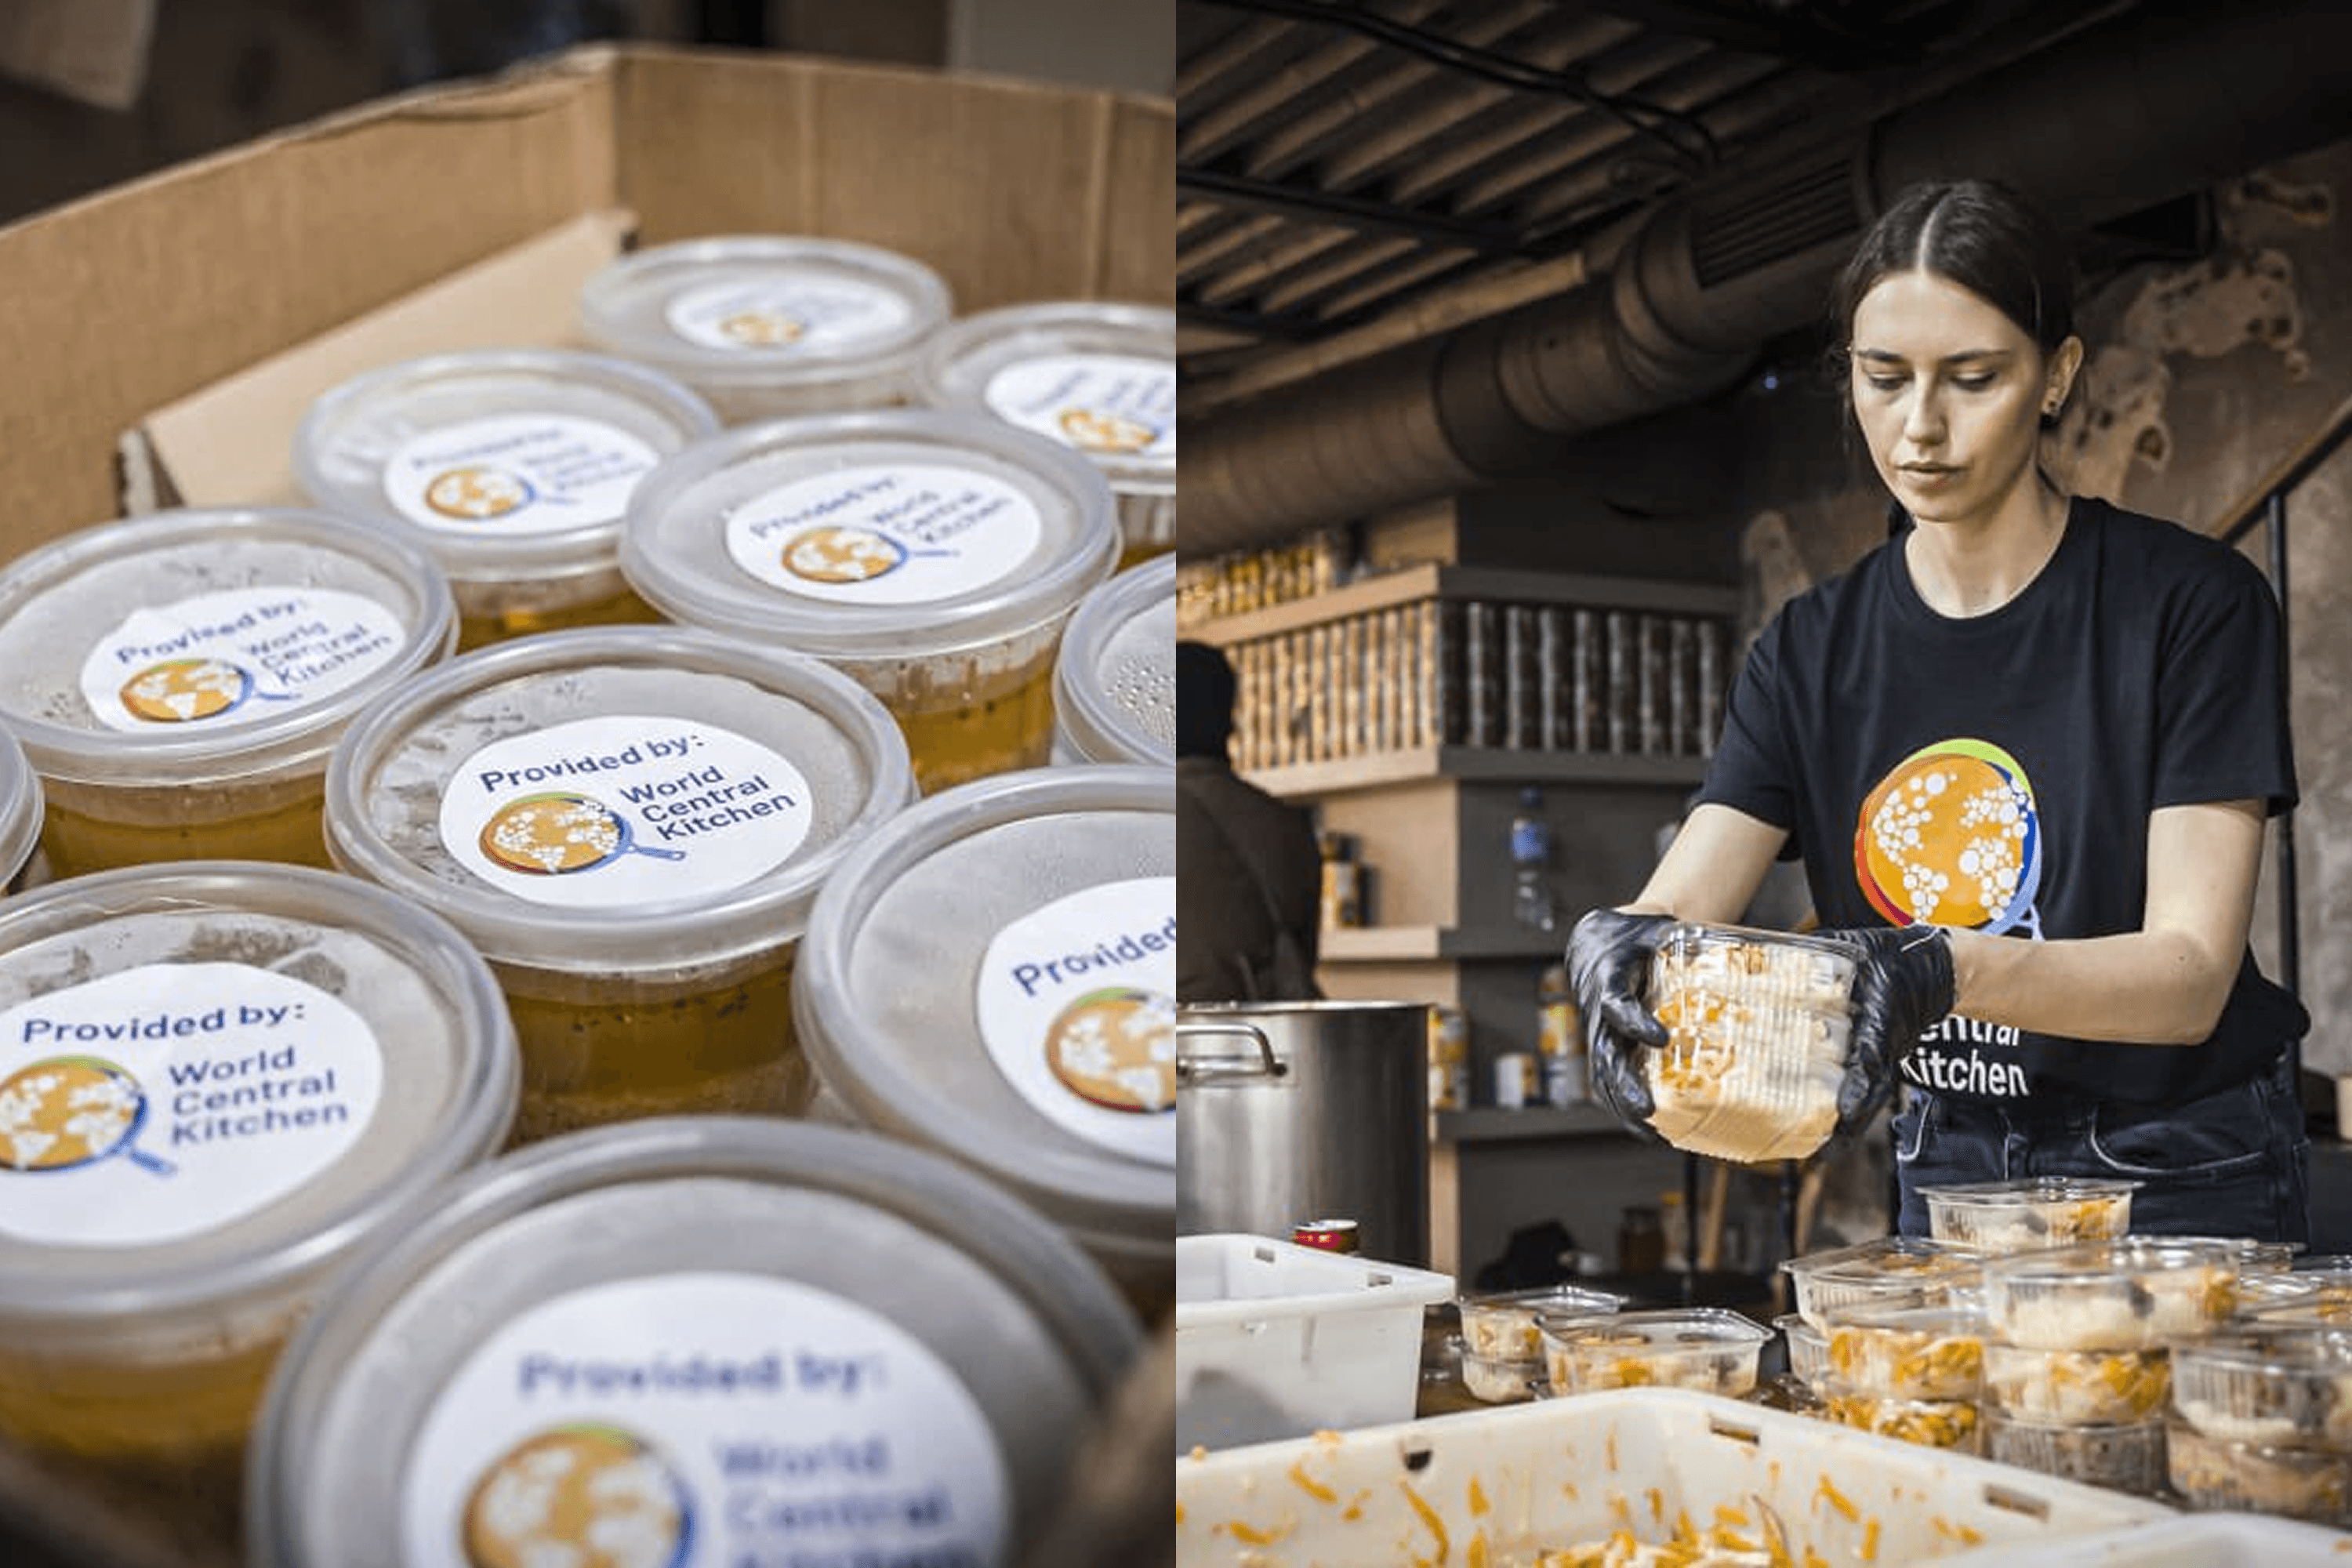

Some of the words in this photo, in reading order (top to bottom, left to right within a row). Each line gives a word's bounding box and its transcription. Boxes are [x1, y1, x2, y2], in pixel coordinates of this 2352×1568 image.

[116, 612, 256, 664] Provided
[238, 622, 328, 657] World
[260, 624, 369, 669] Central
[275, 634, 392, 686] Kitchen
[480, 746, 643, 792] Provided
[647, 735, 705, 757] by:
[619, 765, 724, 805] World
[641, 775, 771, 823] Central
[655, 793, 797, 841] Kitchen
[1011, 916, 1176, 997] Provided
[23, 1007, 226, 1043] Provided
[238, 1003, 305, 1027] by:
[1919, 1013, 2020, 1047] entral
[169, 1045, 296, 1087] World
[172, 1069, 336, 1116] Central
[171, 1102, 350, 1145] Kitchen
